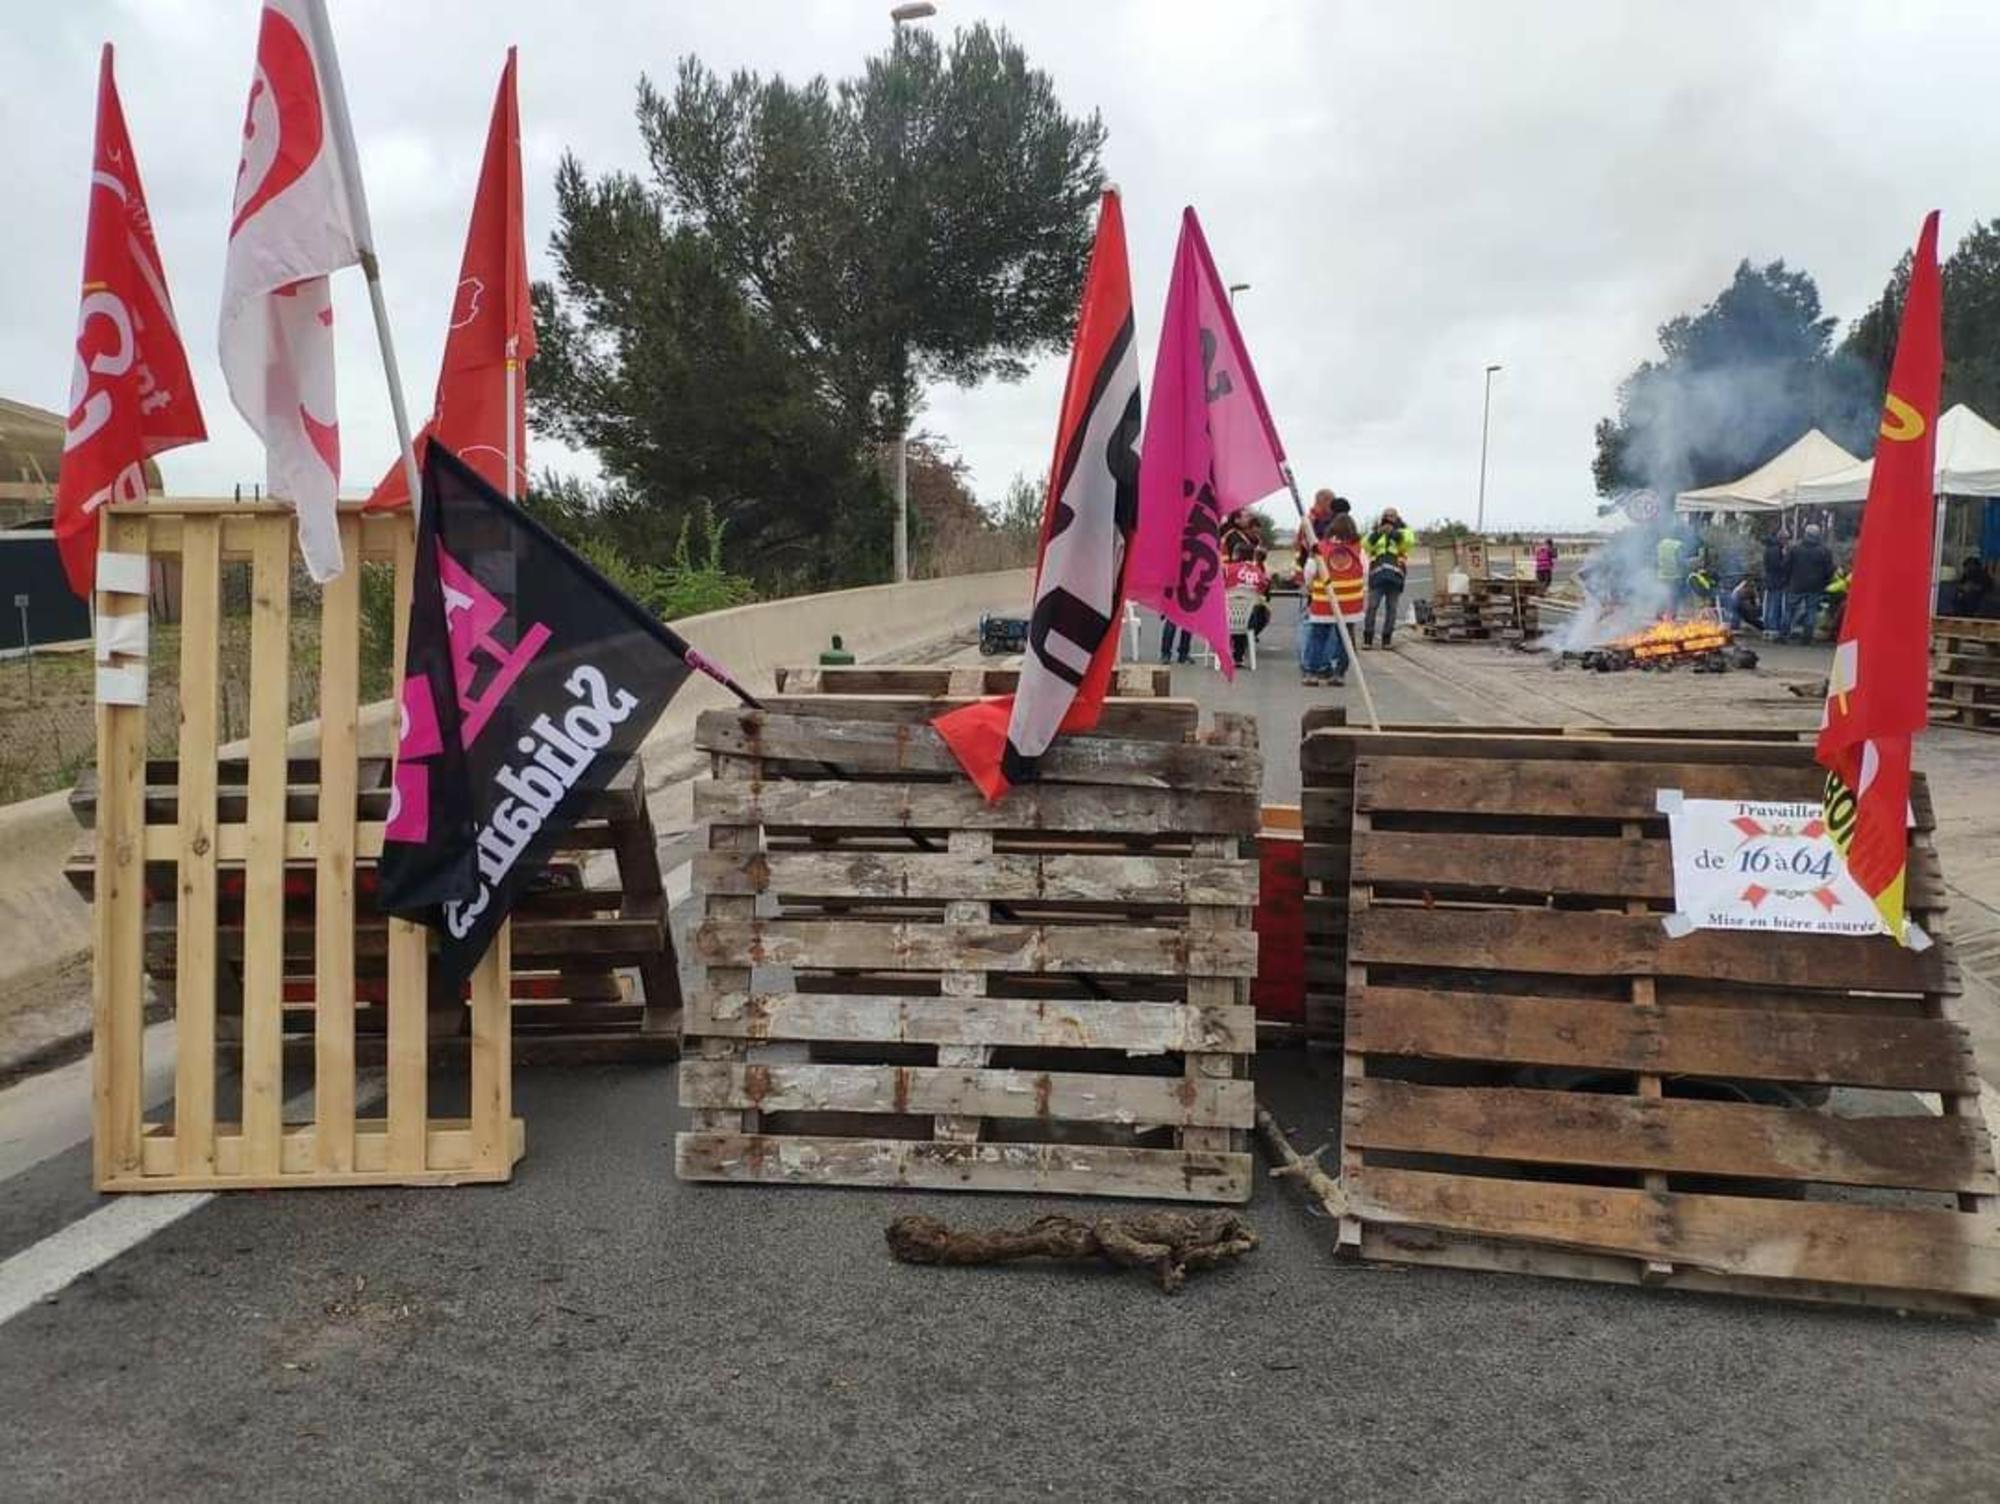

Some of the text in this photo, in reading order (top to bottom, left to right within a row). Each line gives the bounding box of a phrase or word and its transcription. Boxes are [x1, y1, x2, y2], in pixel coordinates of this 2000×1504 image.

[1694, 845, 1833, 880] de 16 à 64
[1707, 913, 1745, 926] Mise
[1749, 917, 1767, 927] en
[1773, 915, 1813, 929] bière
